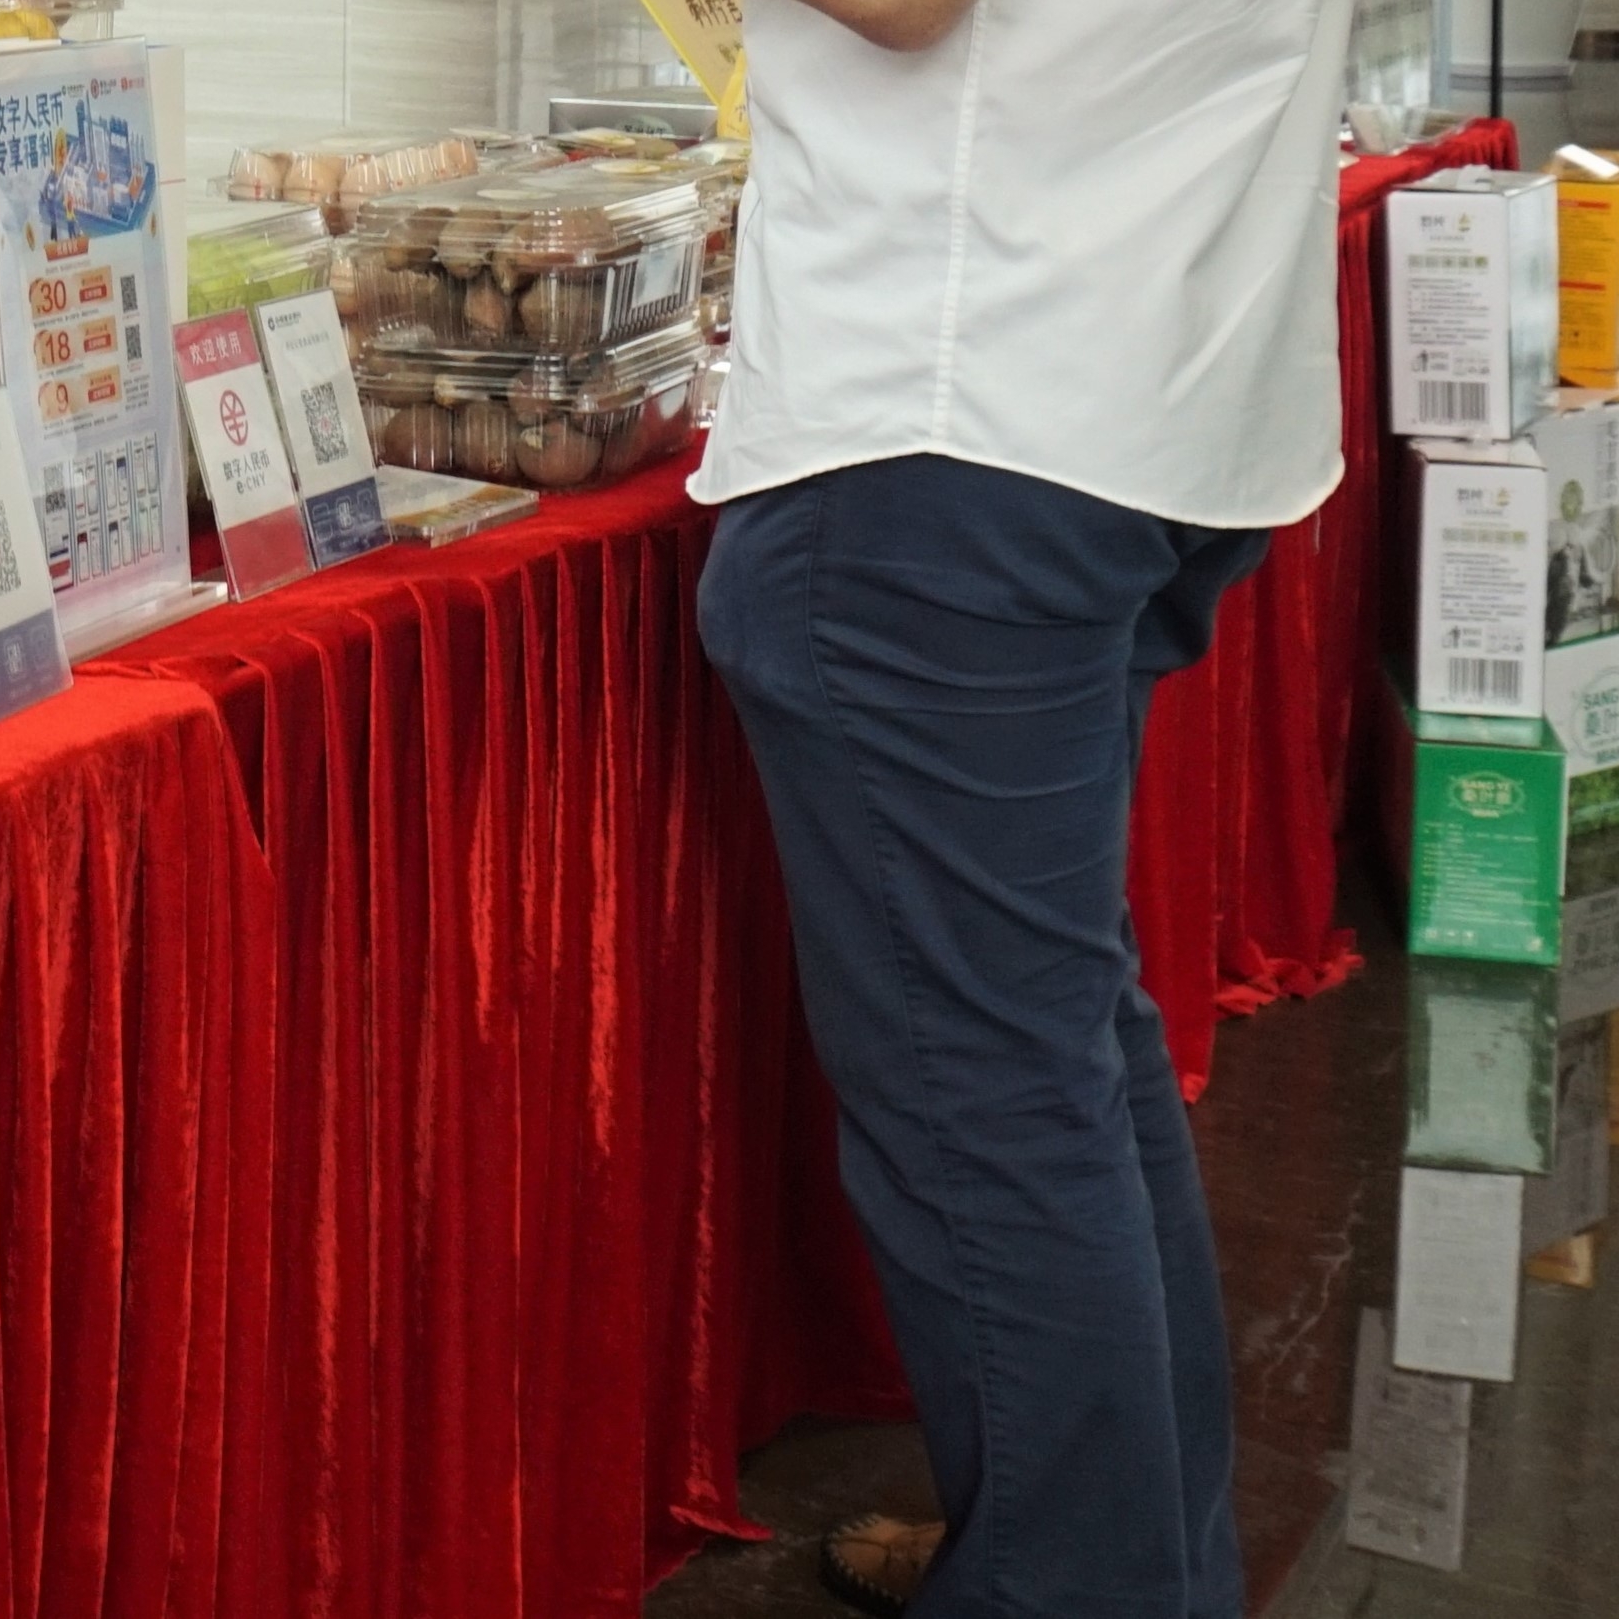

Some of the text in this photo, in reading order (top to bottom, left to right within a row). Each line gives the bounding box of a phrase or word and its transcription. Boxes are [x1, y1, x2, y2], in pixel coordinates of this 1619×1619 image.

[189, 330, 241, 365] 欢迎使用
[222, 448, 271, 482] 数字人民币
